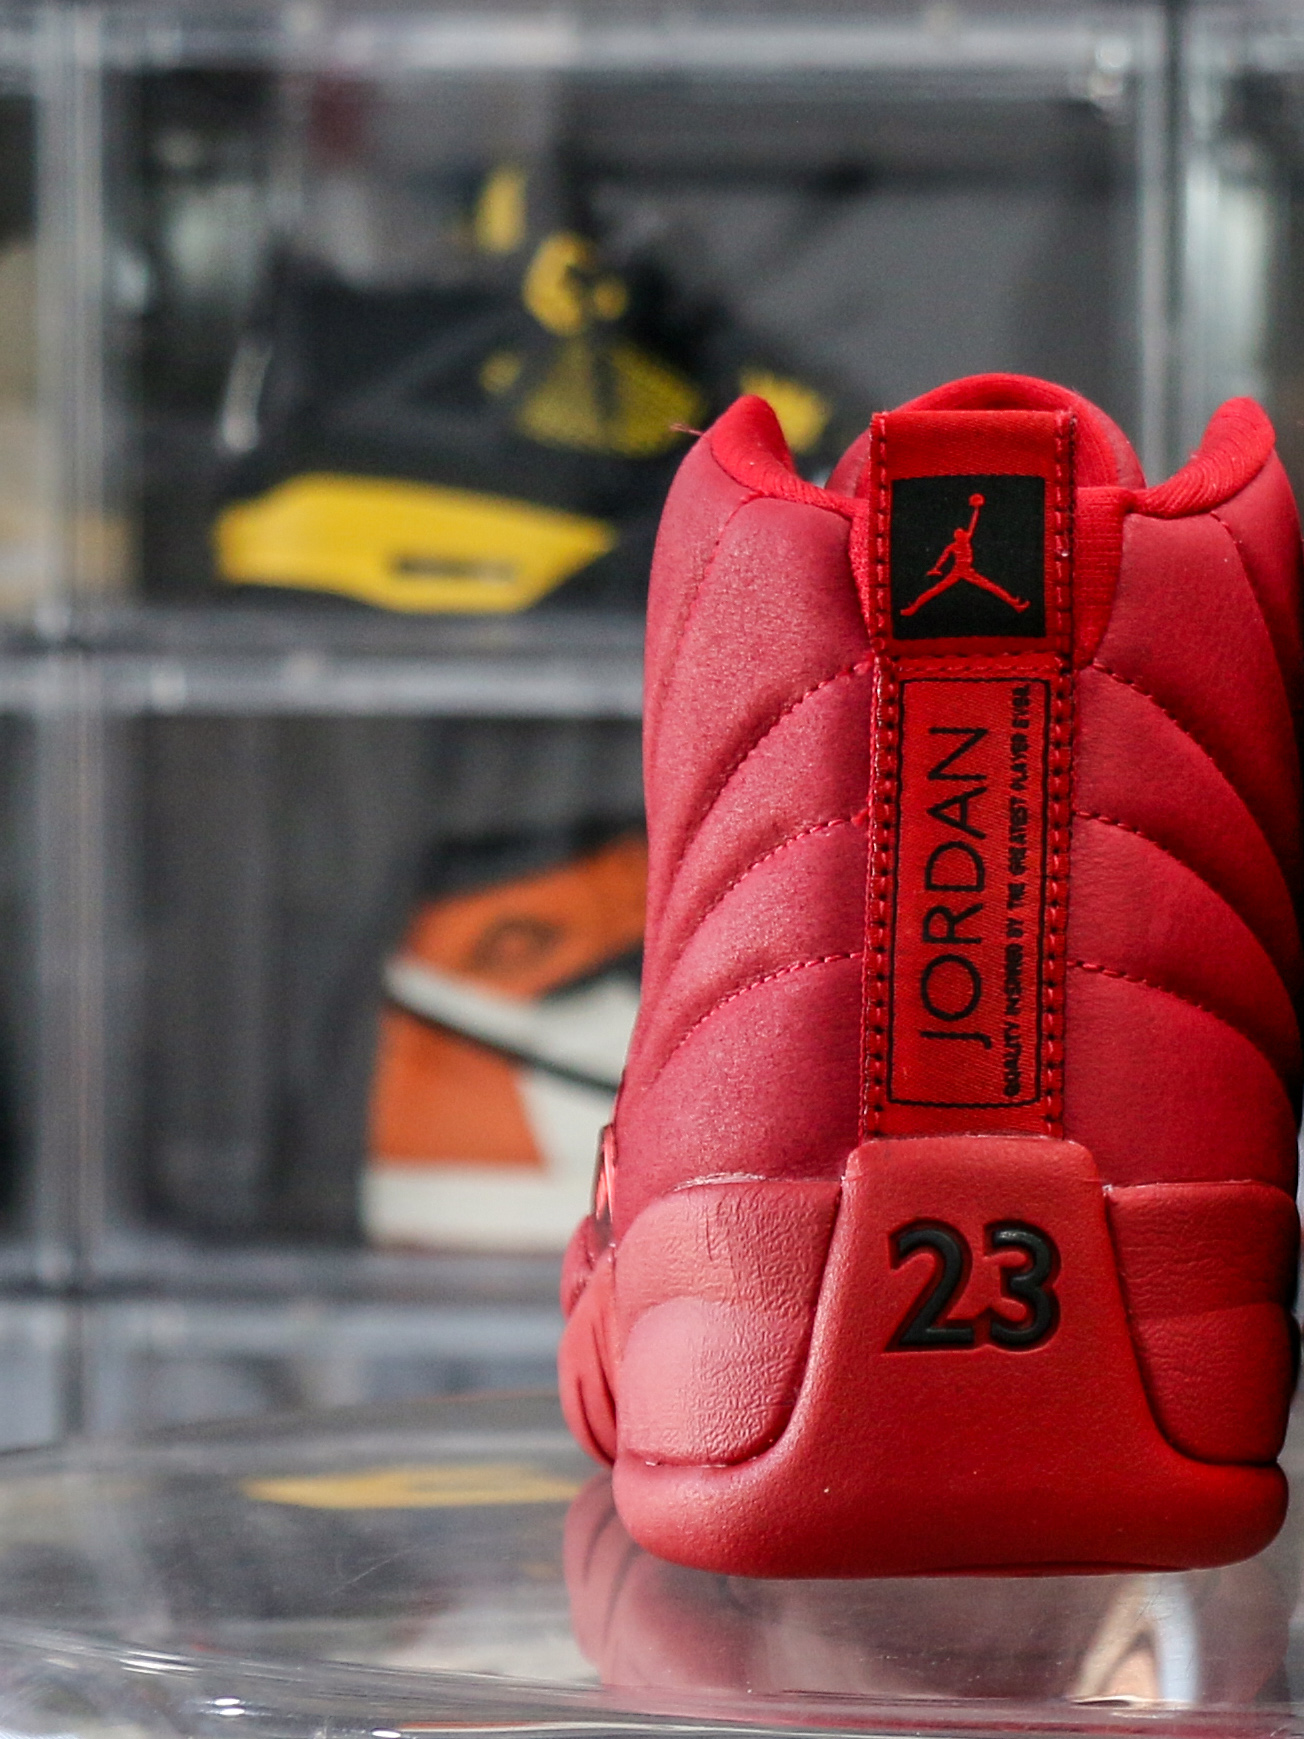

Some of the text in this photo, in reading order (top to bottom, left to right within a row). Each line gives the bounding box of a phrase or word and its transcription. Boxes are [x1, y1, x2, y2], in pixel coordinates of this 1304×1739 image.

[1010, 733, 1031, 791] PLAYER
[1008, 797, 1029, 876] GREATEST
[920, 727, 993, 1050] JORDAN
[1007, 883, 1026, 910] THE
[1006, 917, 1025, 938] BY
[1004, 943, 1024, 1016] INSPIRED
[1003, 1021, 1022, 1096] QUALITY
[885, 1217, 1061, 1353] 23
